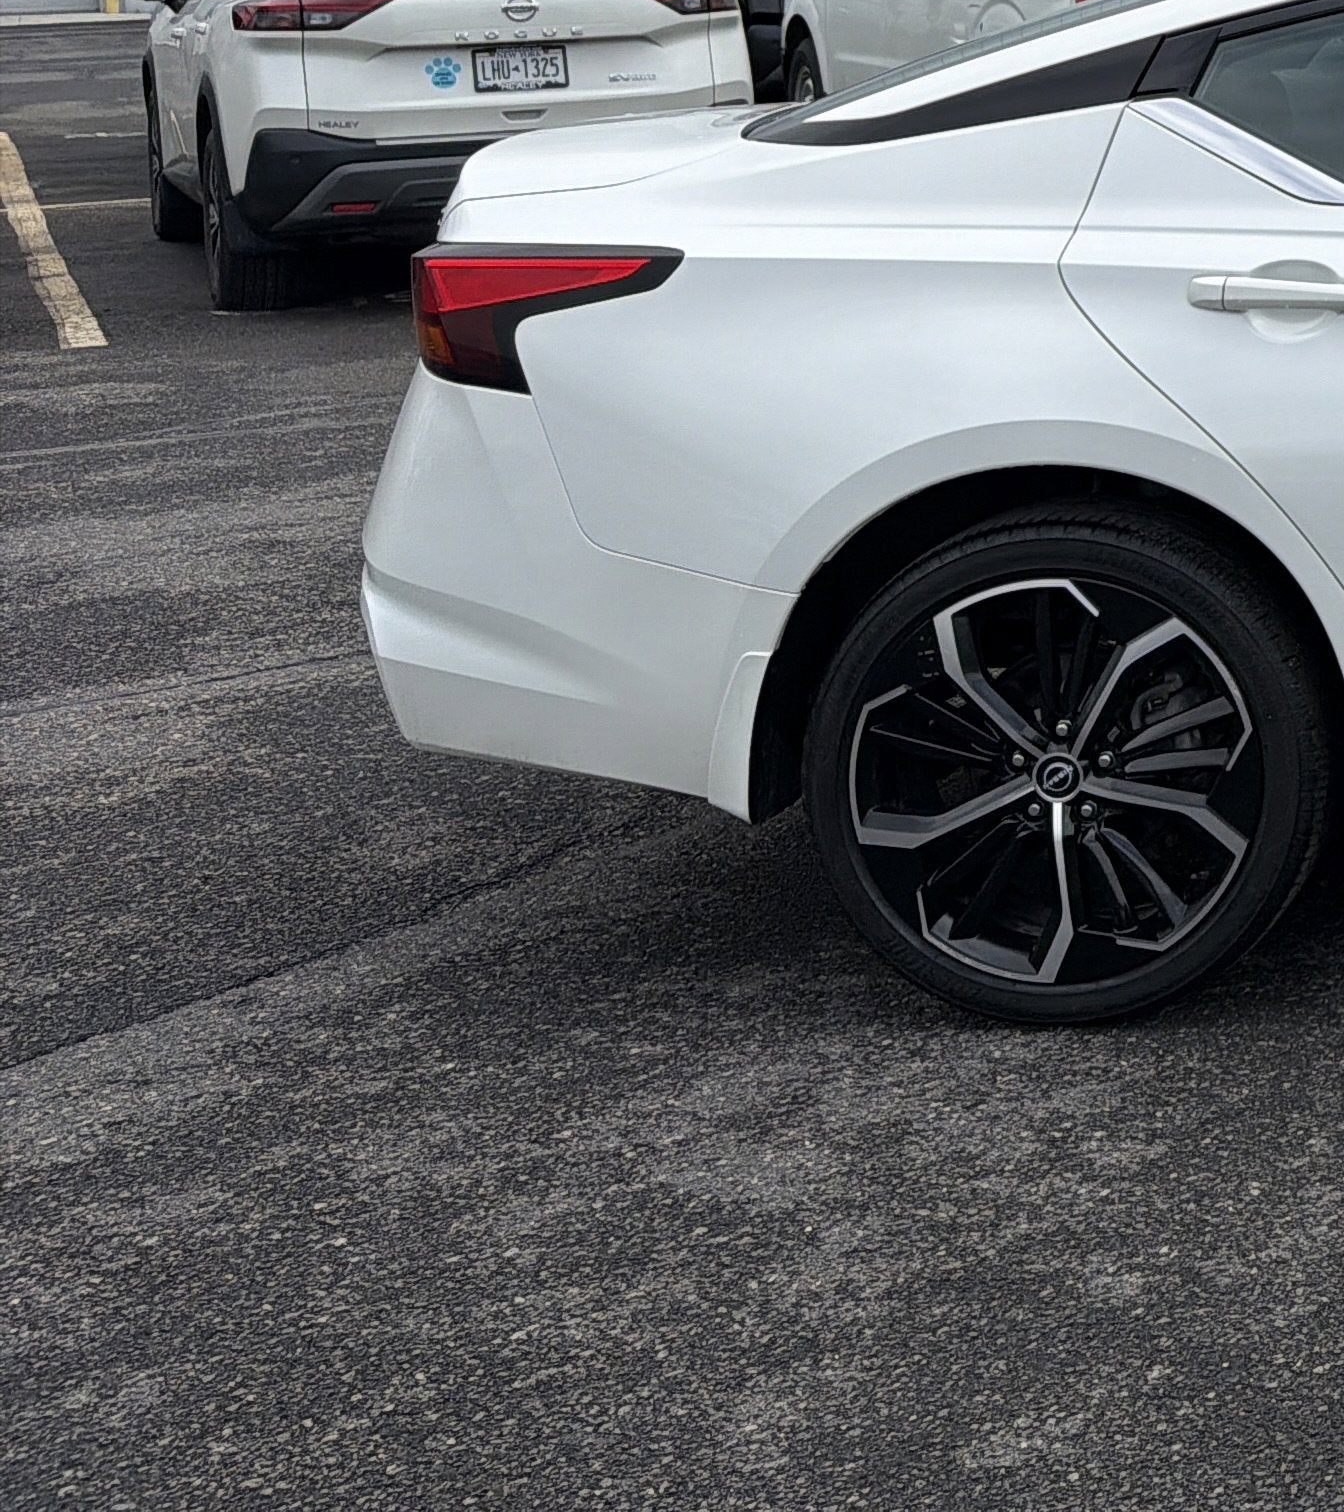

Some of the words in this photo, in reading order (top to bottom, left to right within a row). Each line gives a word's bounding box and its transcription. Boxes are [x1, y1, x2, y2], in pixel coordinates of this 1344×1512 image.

[455, 25, 583, 41] ROGUE
[497, 49, 518, 58] NEW
[318, 120, 359, 128] HEALEY
